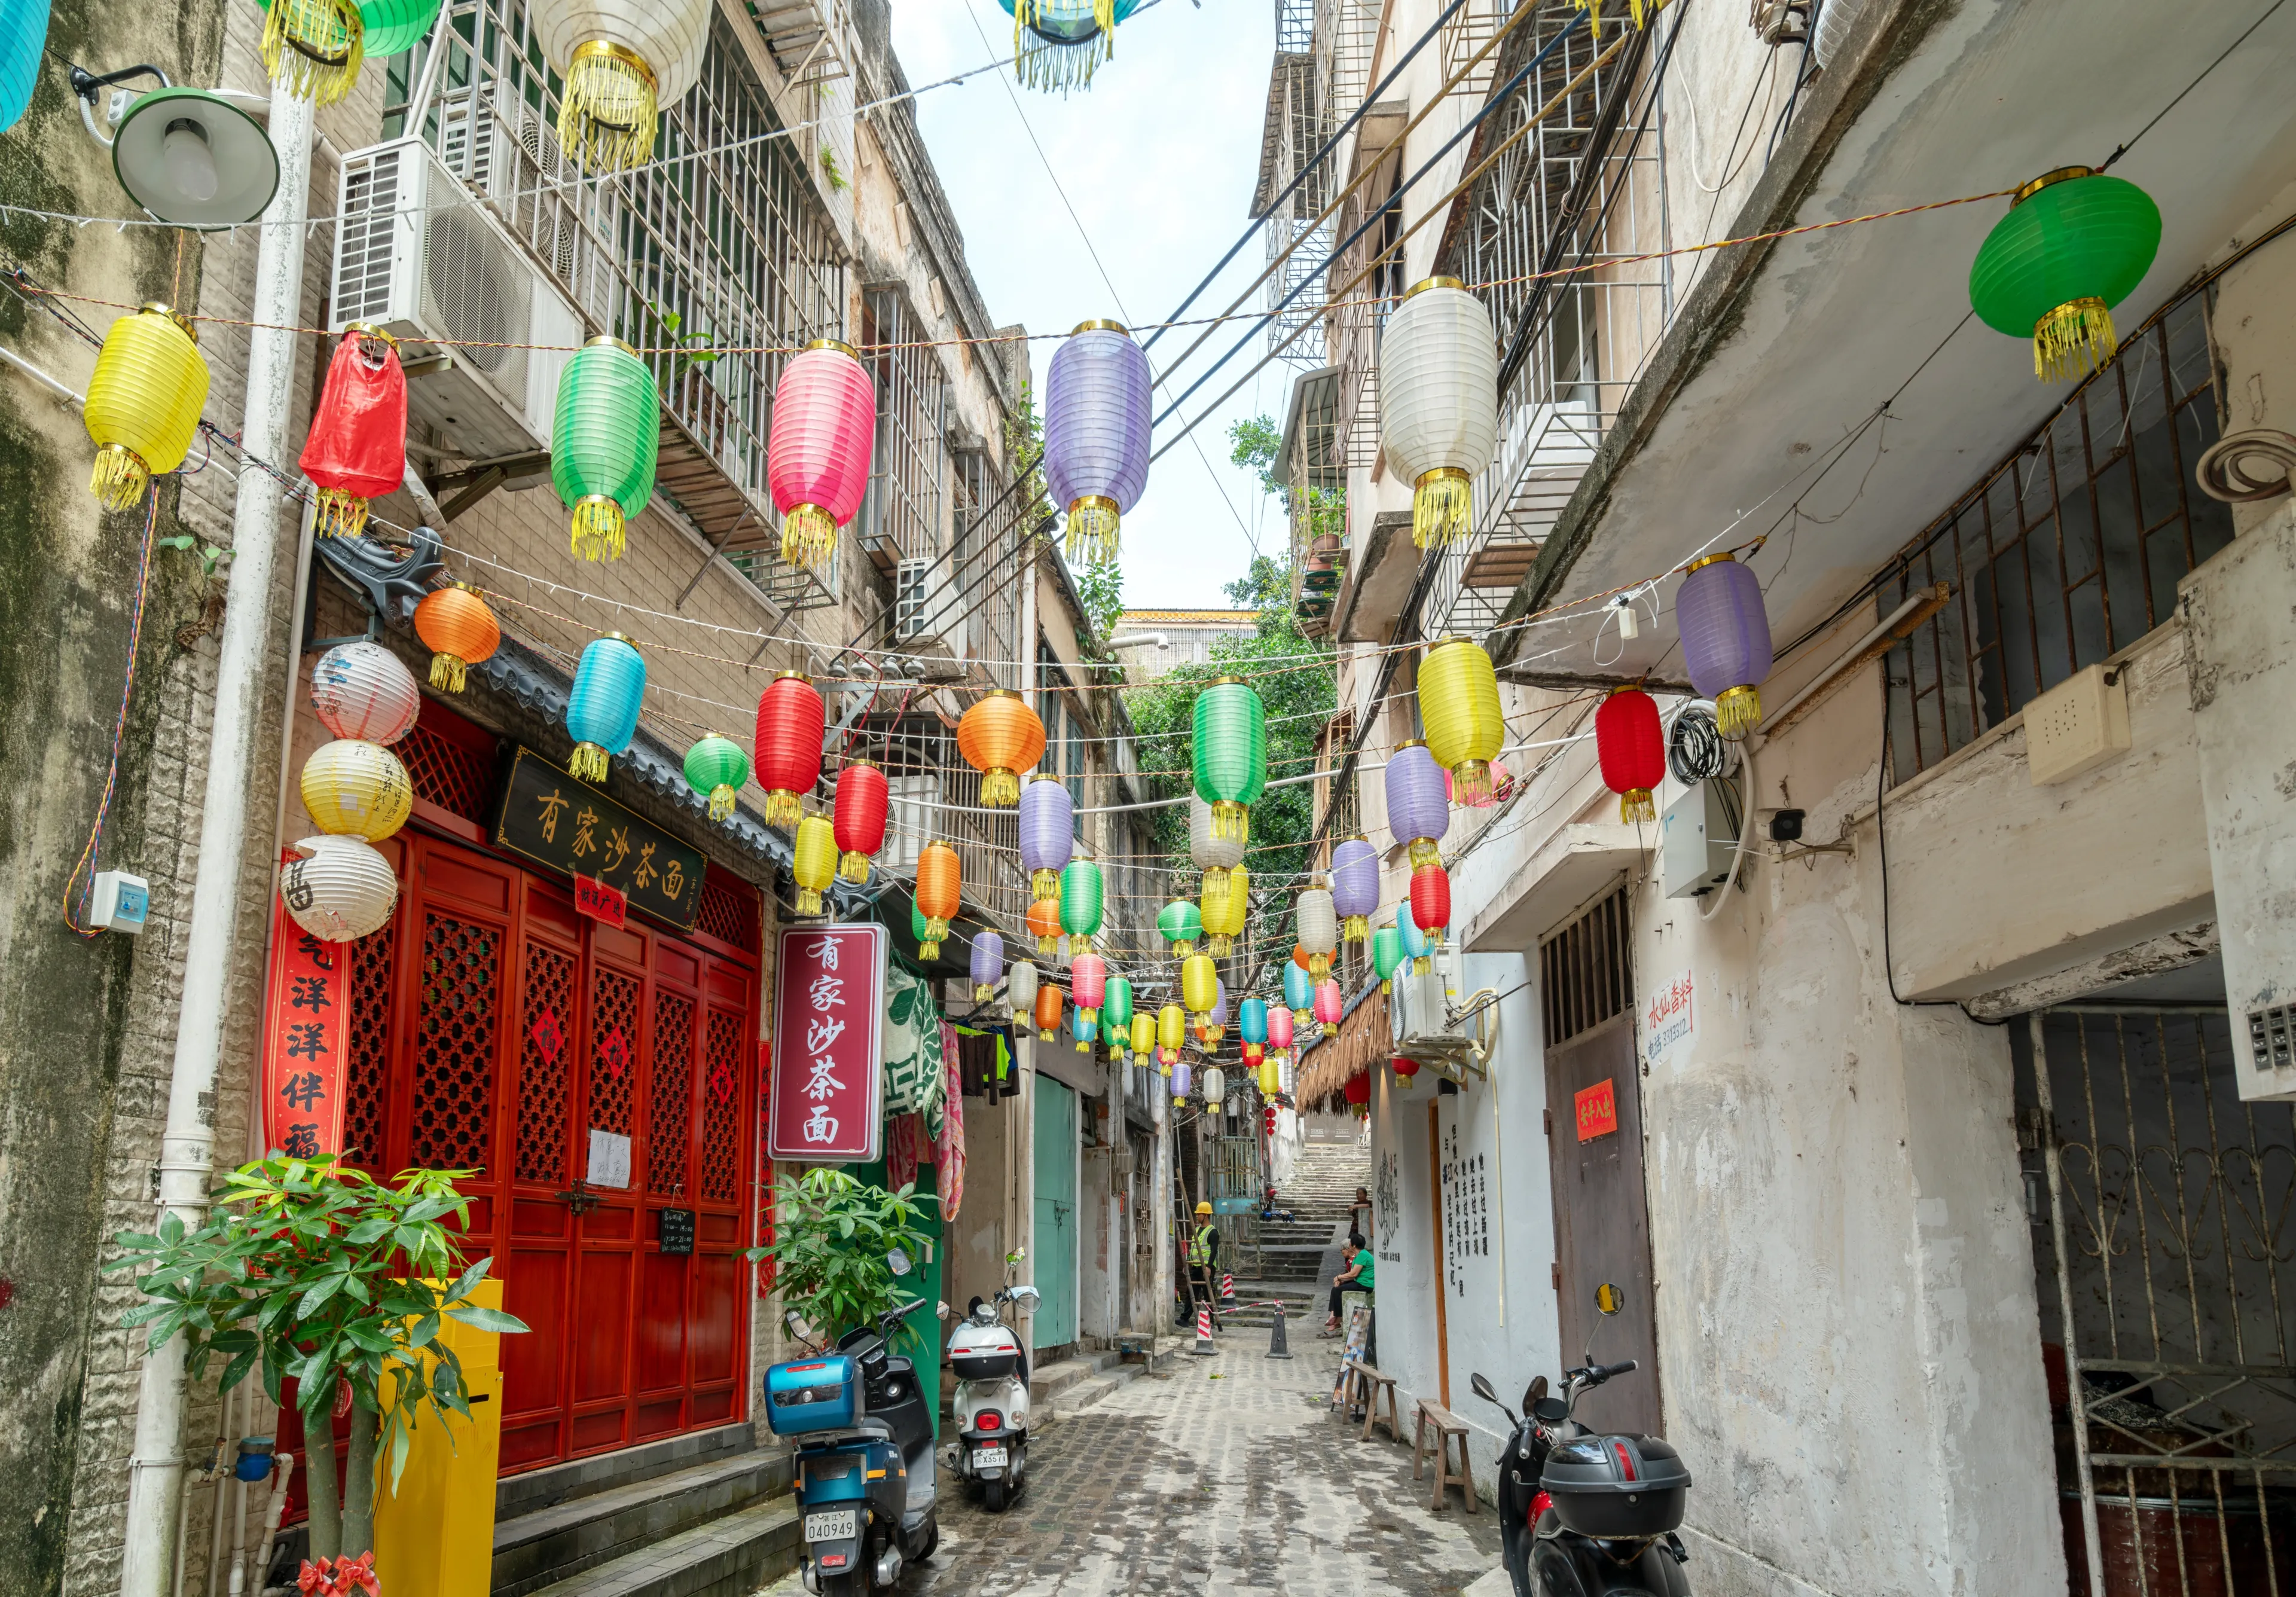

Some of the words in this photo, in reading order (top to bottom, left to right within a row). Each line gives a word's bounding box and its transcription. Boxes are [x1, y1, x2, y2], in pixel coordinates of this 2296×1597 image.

[538, 789, 683, 900] 有家沙茶面
[581, 887, 621, 917] 财源广进
[1648, 969, 1693, 1033] 水仙香料
[539, 1019, 556, 1054] 福
[607, 1036, 624, 1068] 福
[801, 935, 846, 1144] 有家沙茶面
[1648, 1033, 1662, 1059] 电话
[596, 1137, 627, 1158] 休息一天
[809, 1522, 853, 1538] 040949
